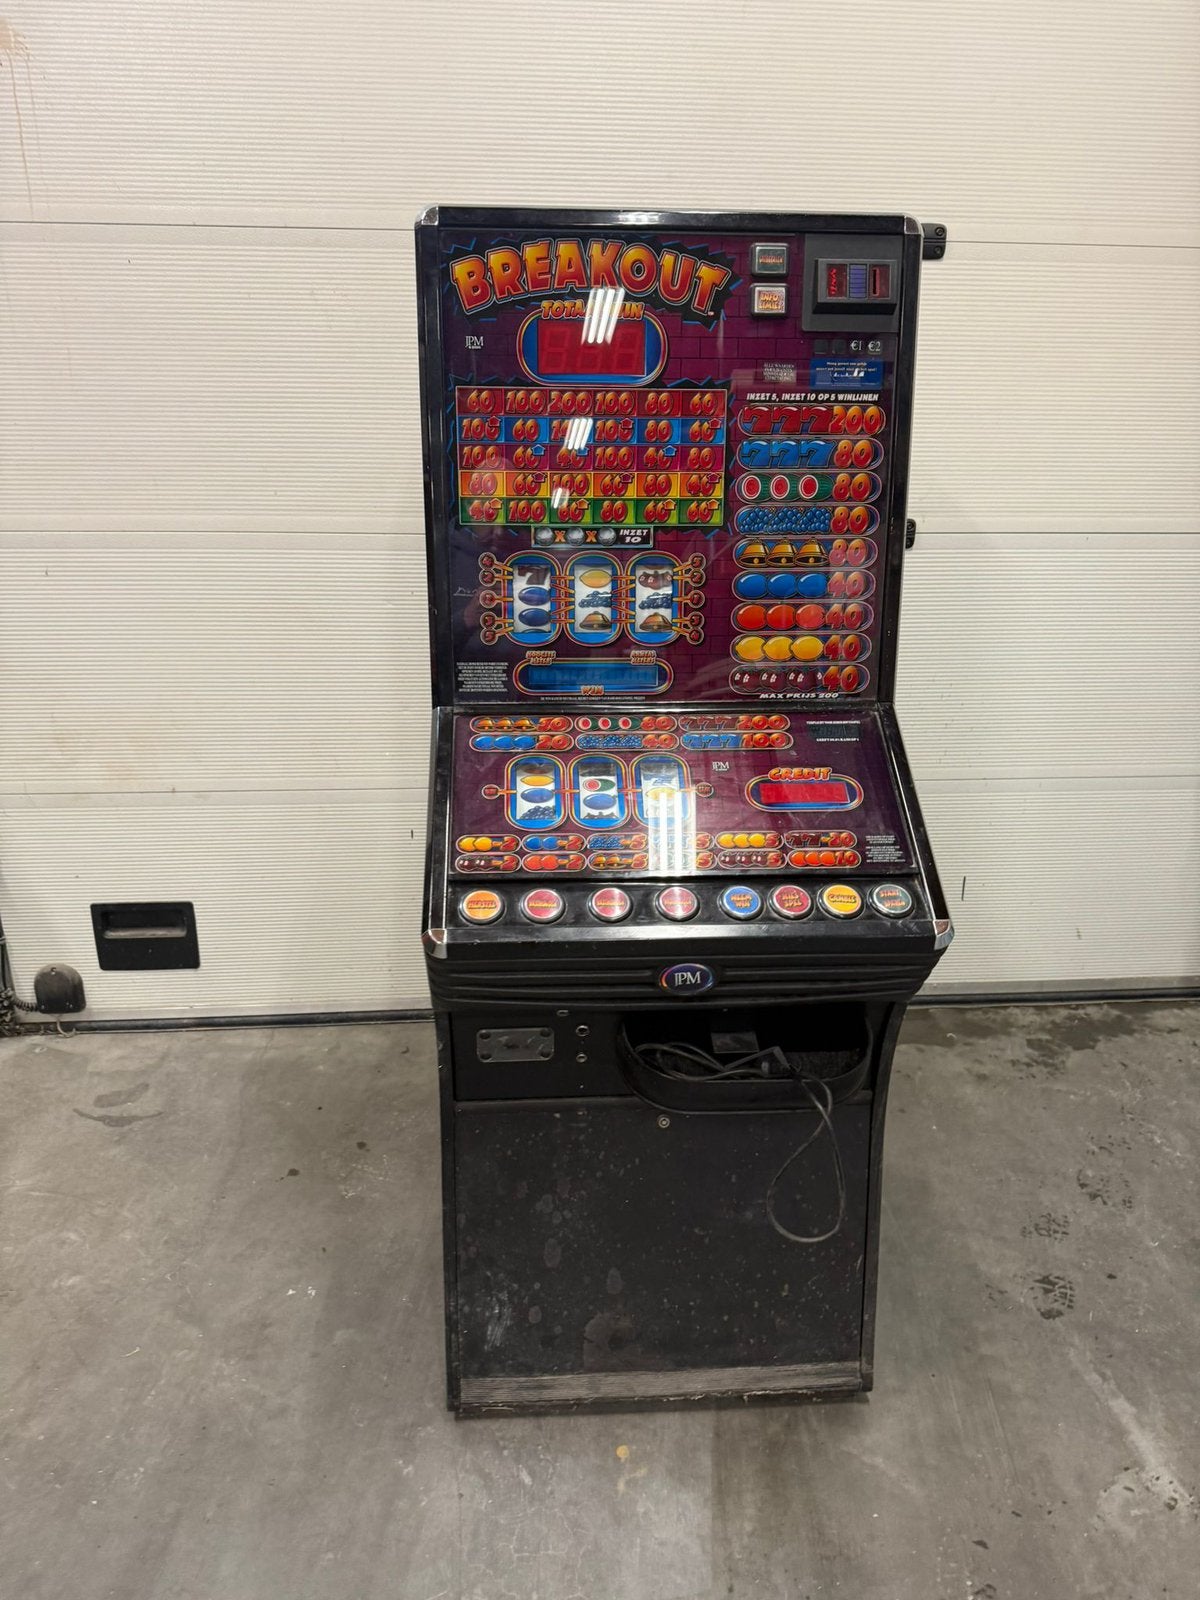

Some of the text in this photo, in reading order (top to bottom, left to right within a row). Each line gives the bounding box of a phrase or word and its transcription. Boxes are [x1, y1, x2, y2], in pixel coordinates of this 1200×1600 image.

[451, 238, 731, 314] BREAKOUT
[465, 336, 483, 347] JPM
[850, 340, 862, 351] €1
[868, 341, 881, 352] €2
[467, 389, 496, 412] 60
[505, 390, 545, 413] 100
[547, 391, 592, 414] 200
[594, 391, 634, 415] 100
[645, 392, 673, 415] 80
[689, 392, 717, 415] 60
[747, 393, 769, 401] INZET
[771, 393, 779, 403] 5,
[781, 393, 804, 402] INZET
[818, 393, 829, 401] OP
[838, 393, 879, 402] WINLIJNEN
[512, 418, 540, 441] 60
[644, 420, 672, 442] 80
[828, 405, 882, 435] 200
[462, 445, 499, 468] 100
[594, 446, 633, 470] 100
[687, 447, 715, 470] 80
[833, 439, 874, 469] 80
[469, 472, 497, 495] 80
[644, 474, 671, 497] 80
[832, 473, 873, 502] 80
[508, 500, 545, 523] 100
[601, 501, 628, 523] 80
[831, 506, 870, 535] 80
[829, 538, 868, 567] 80
[827, 571, 867, 599] 40
[825, 603, 864, 630] 40
[823, 634, 862, 661] 40
[822, 665, 860, 692] 40
[640, 716, 674, 731] 80
[736, 715, 787, 730] 200
[535, 734, 570, 750] 20
[642, 734, 676, 749] 40
[741, 733, 787, 748] 100
[712, 761, 729, 770] JPM
[768, 768, 832, 782] CREDIT
[828, 832, 855, 847] 20
[836, 850, 859, 866] 10
[674, 971, 701, 986] JPM
